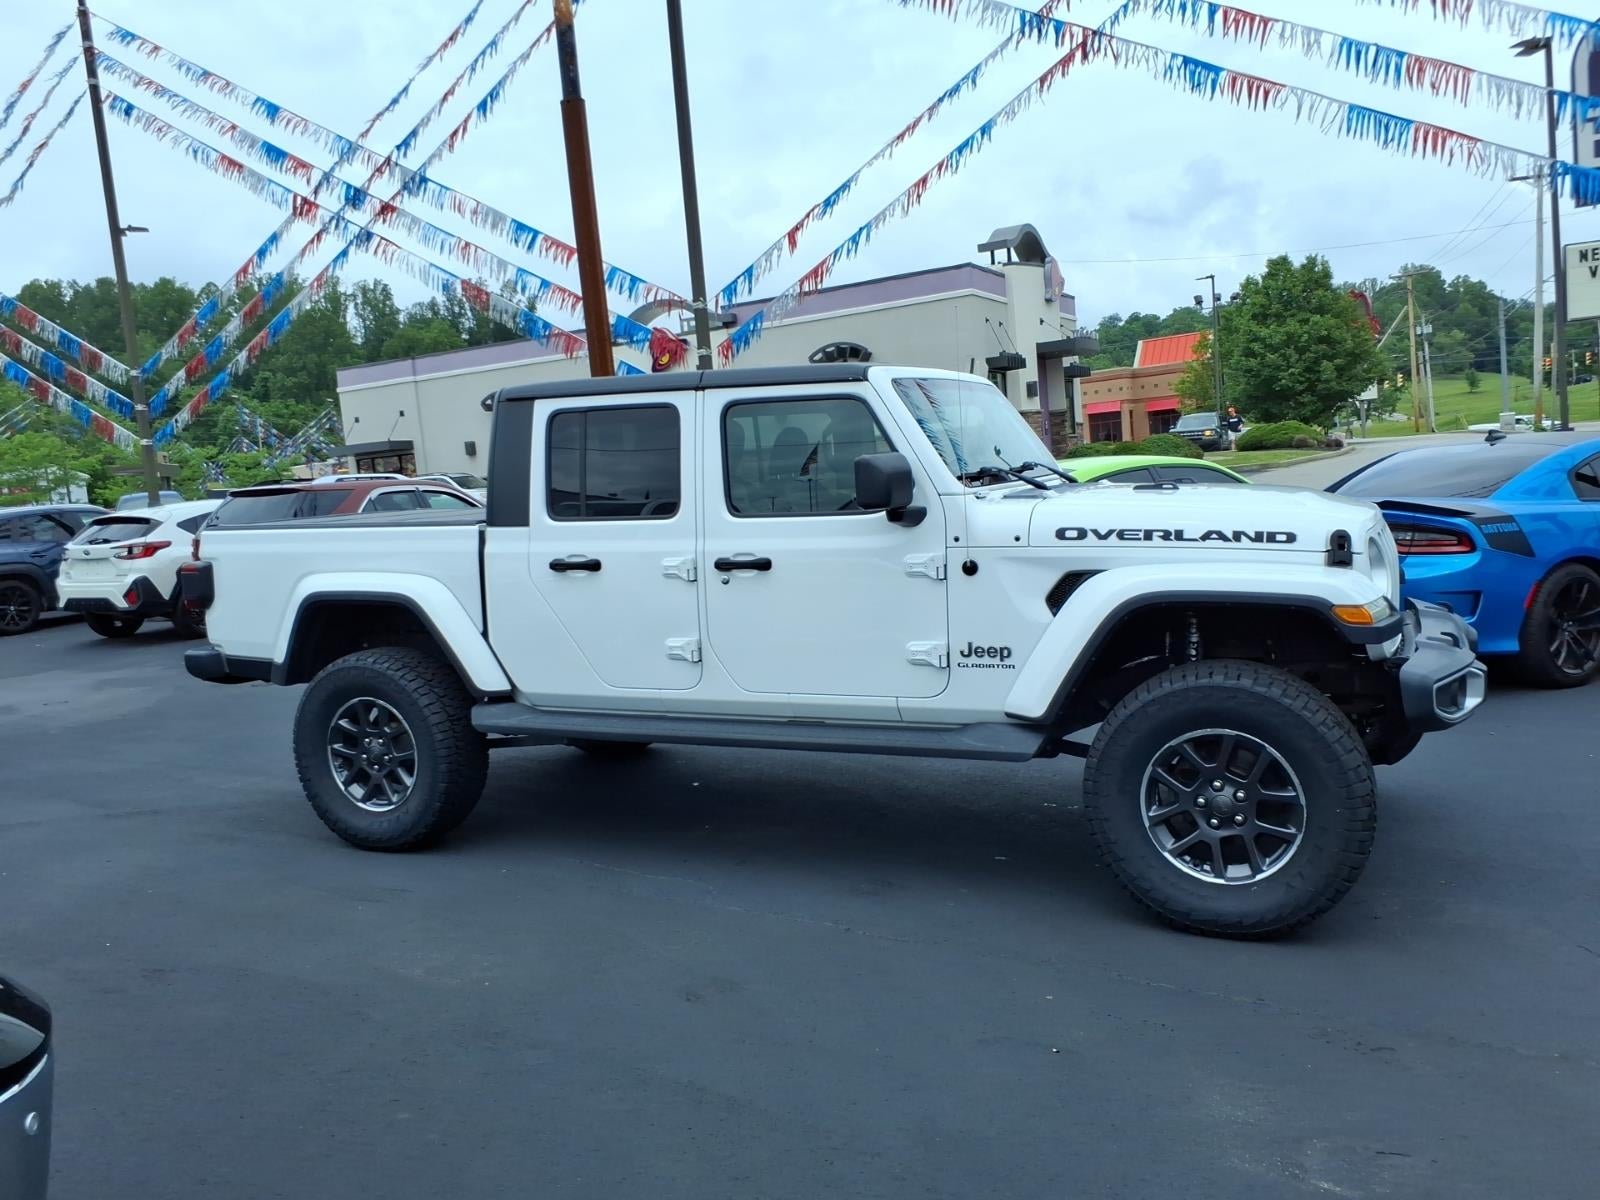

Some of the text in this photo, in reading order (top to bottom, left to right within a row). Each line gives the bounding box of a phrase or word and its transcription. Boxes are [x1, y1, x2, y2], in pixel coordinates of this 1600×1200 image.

[1055, 527, 1298, 544] OVERLAND
[960, 641, 1012, 662] Jeep
[957, 662, 1016, 670] GLADIATOR
